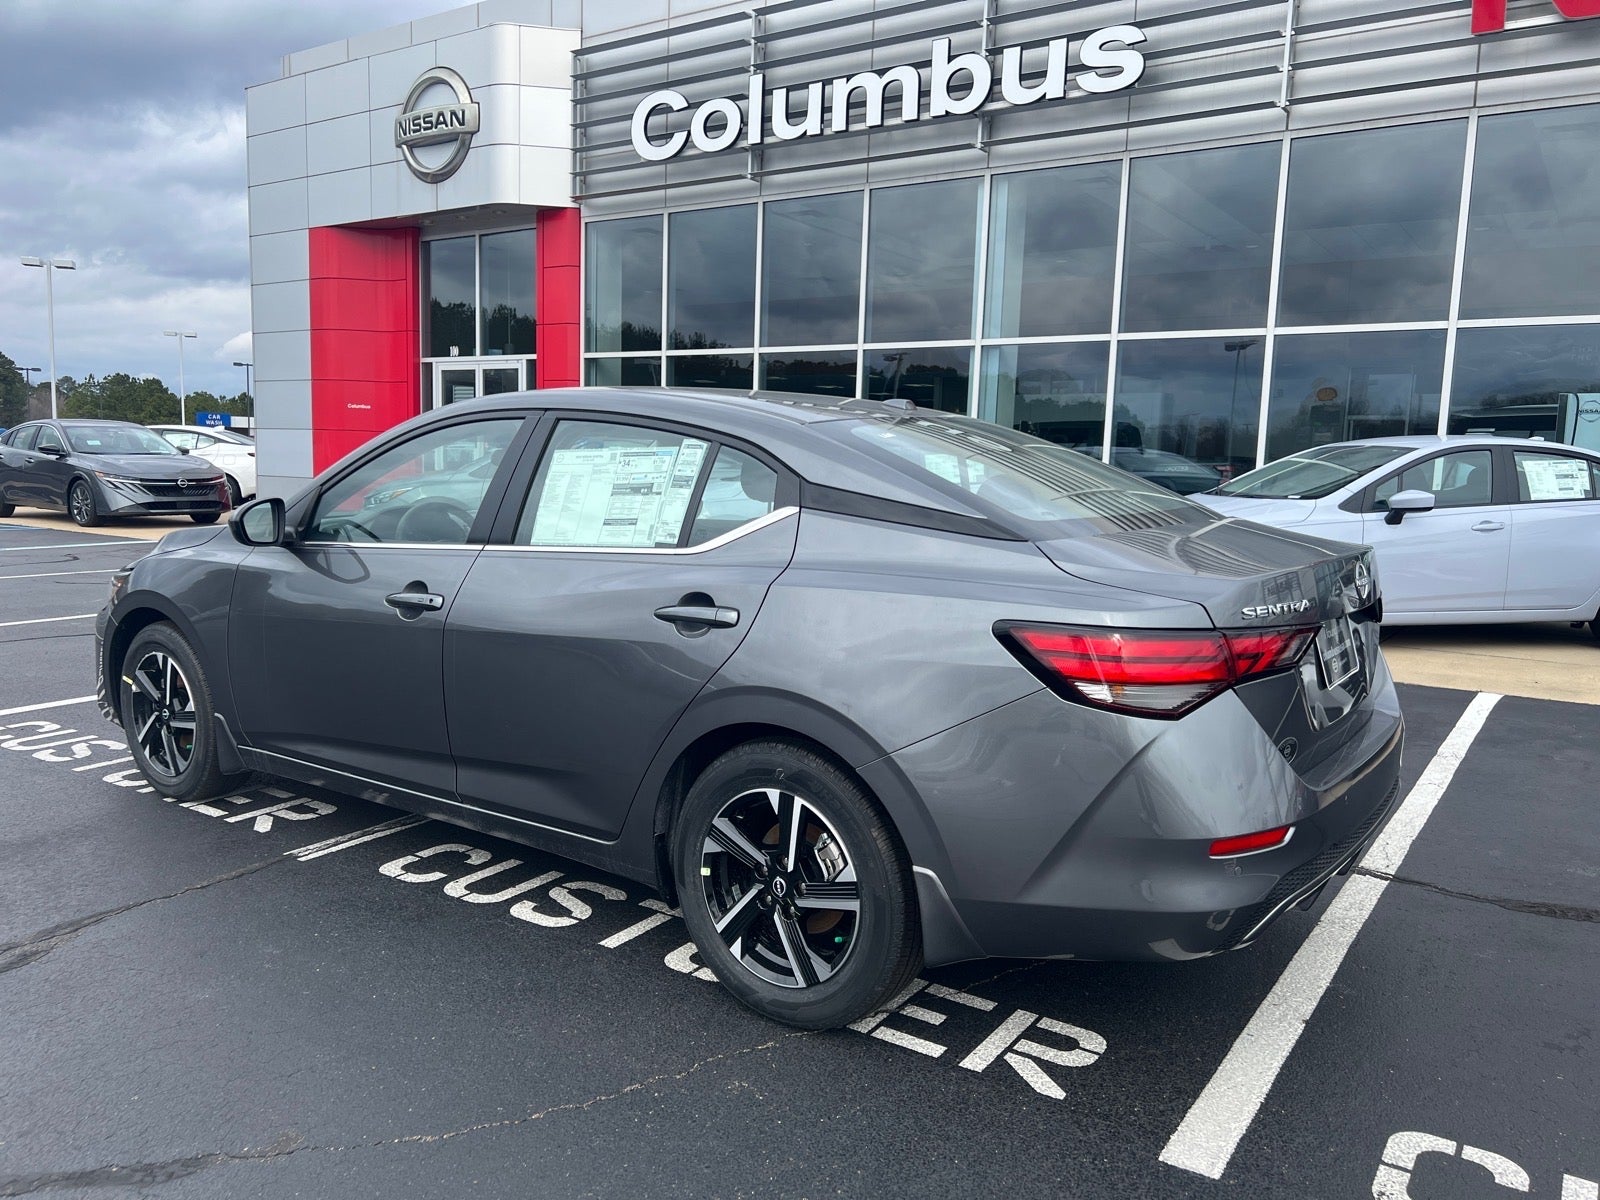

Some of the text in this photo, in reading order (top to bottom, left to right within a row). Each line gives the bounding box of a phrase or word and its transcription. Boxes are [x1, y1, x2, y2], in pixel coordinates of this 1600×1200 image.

[630, 24, 1147, 161] Columbus
[397, 108, 466, 140] NISSAN
[449, 345, 459, 357] 100
[1241, 599, 1310, 620] SENTRA
[378, 843, 1108, 1100] CUSTER
